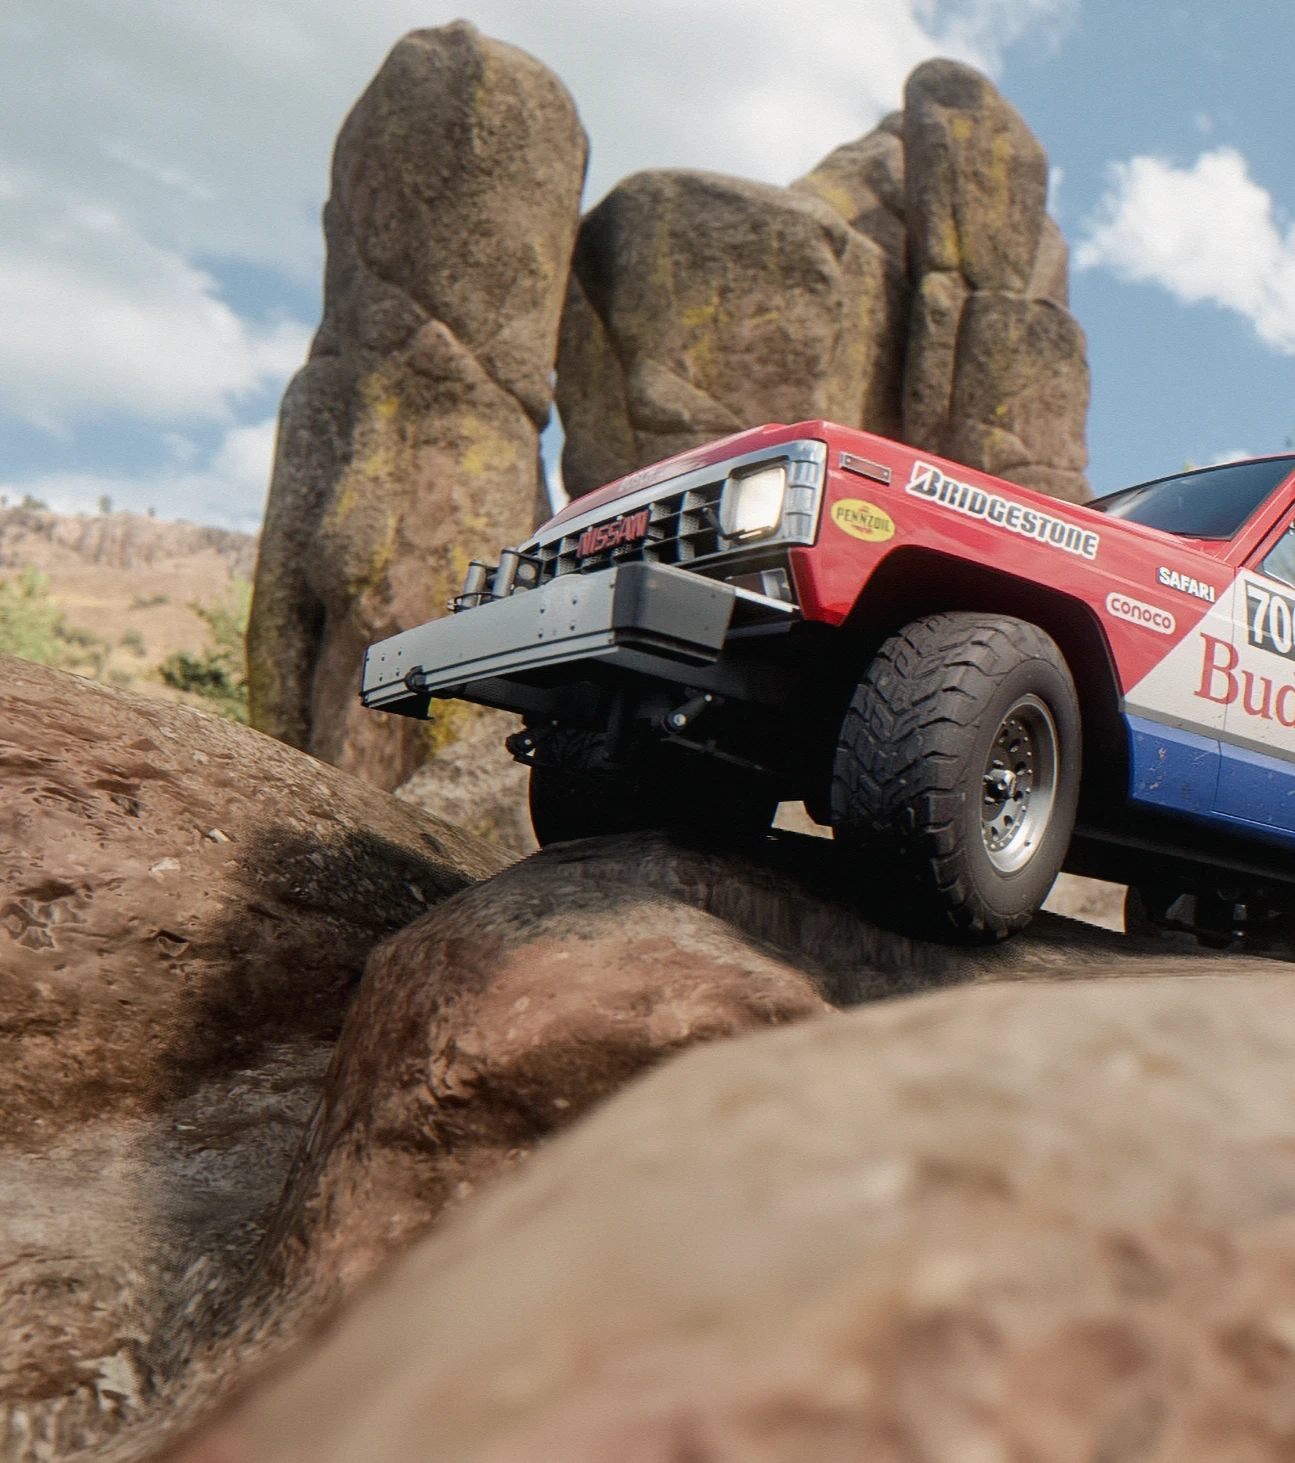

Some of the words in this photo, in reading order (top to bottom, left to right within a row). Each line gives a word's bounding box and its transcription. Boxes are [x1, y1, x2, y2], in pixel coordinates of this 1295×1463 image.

[836, 507, 891, 532] PENNZOIL
[908, 464, 1098, 557] BRIDGESTONE
[577, 509, 650, 558] NISSAN
[1157, 566, 1216, 604] SAFARI
[1110, 598, 1172, 629] conoco
